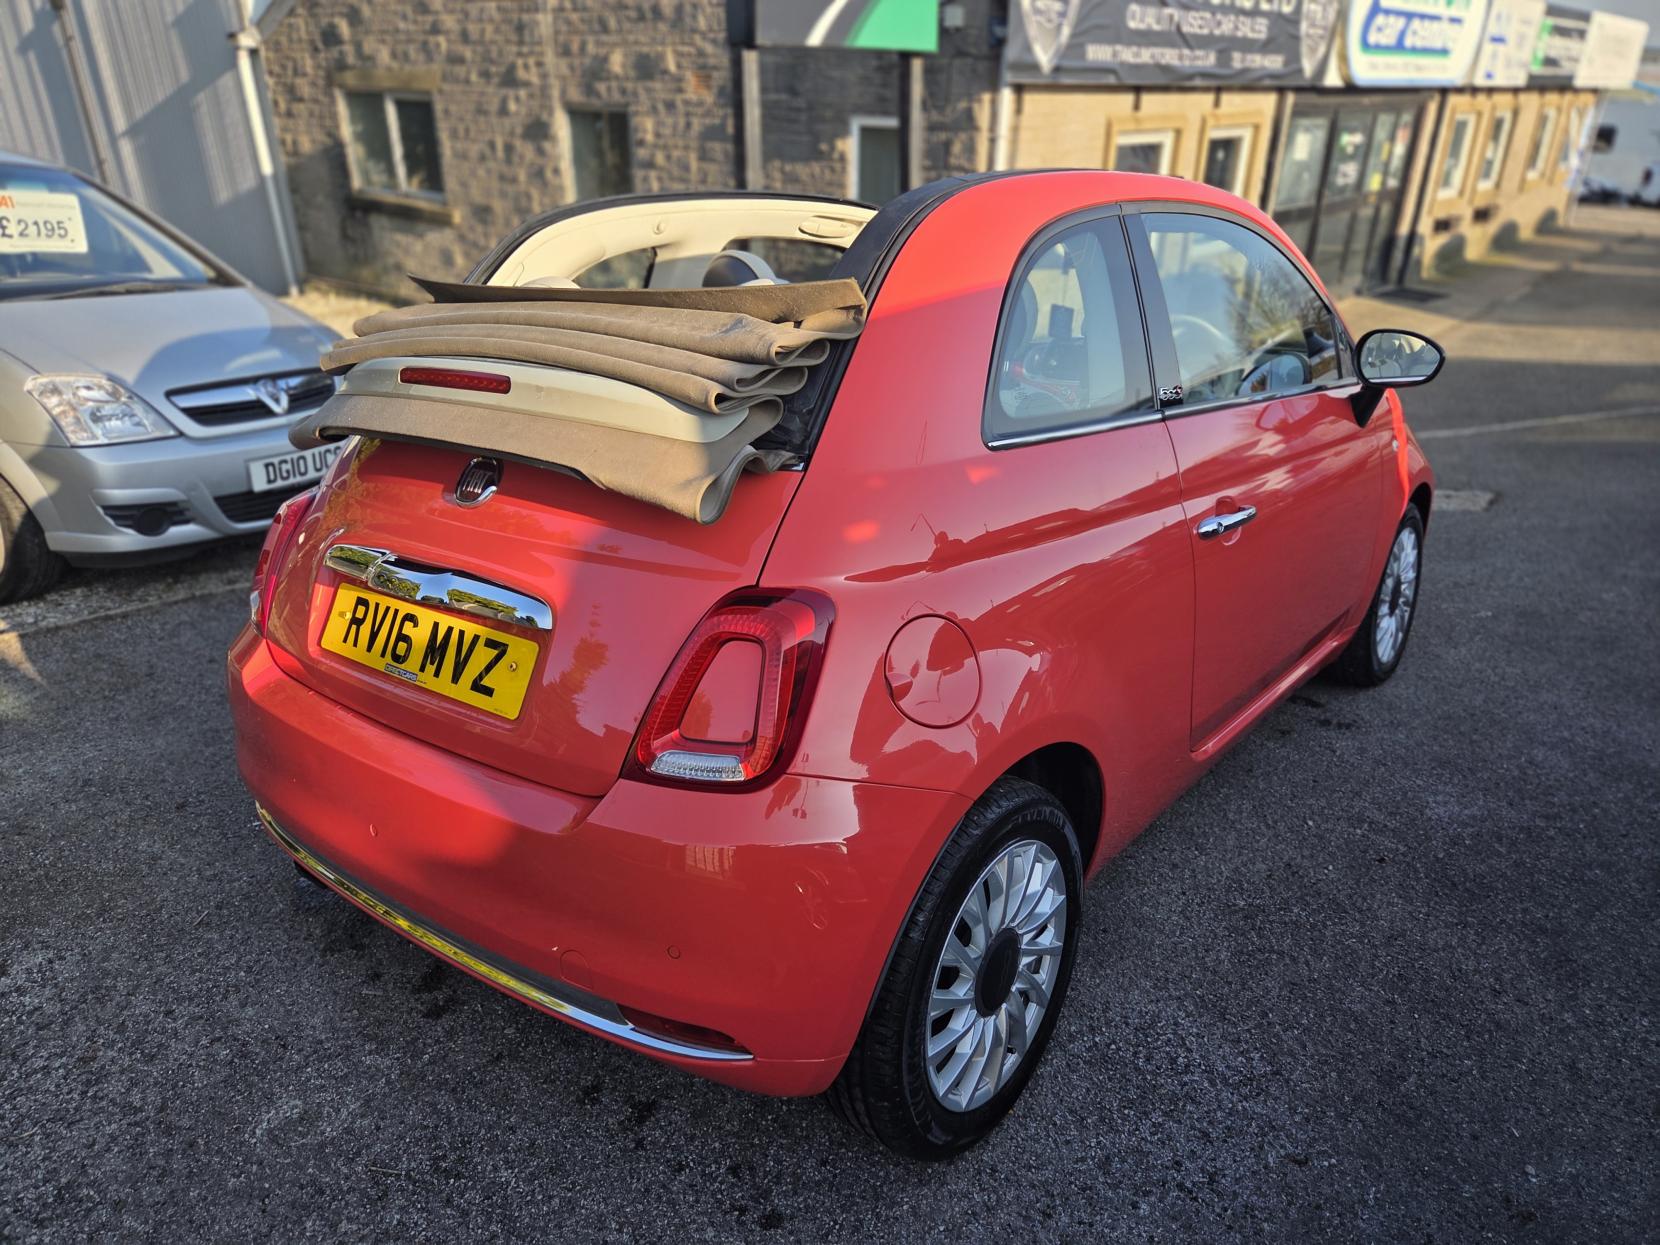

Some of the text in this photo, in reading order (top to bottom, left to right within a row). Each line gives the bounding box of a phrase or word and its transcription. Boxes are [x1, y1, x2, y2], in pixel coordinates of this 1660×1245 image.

[264, 455, 308, 485] DG10
[342, 596, 510, 698] RV16 MVZ
